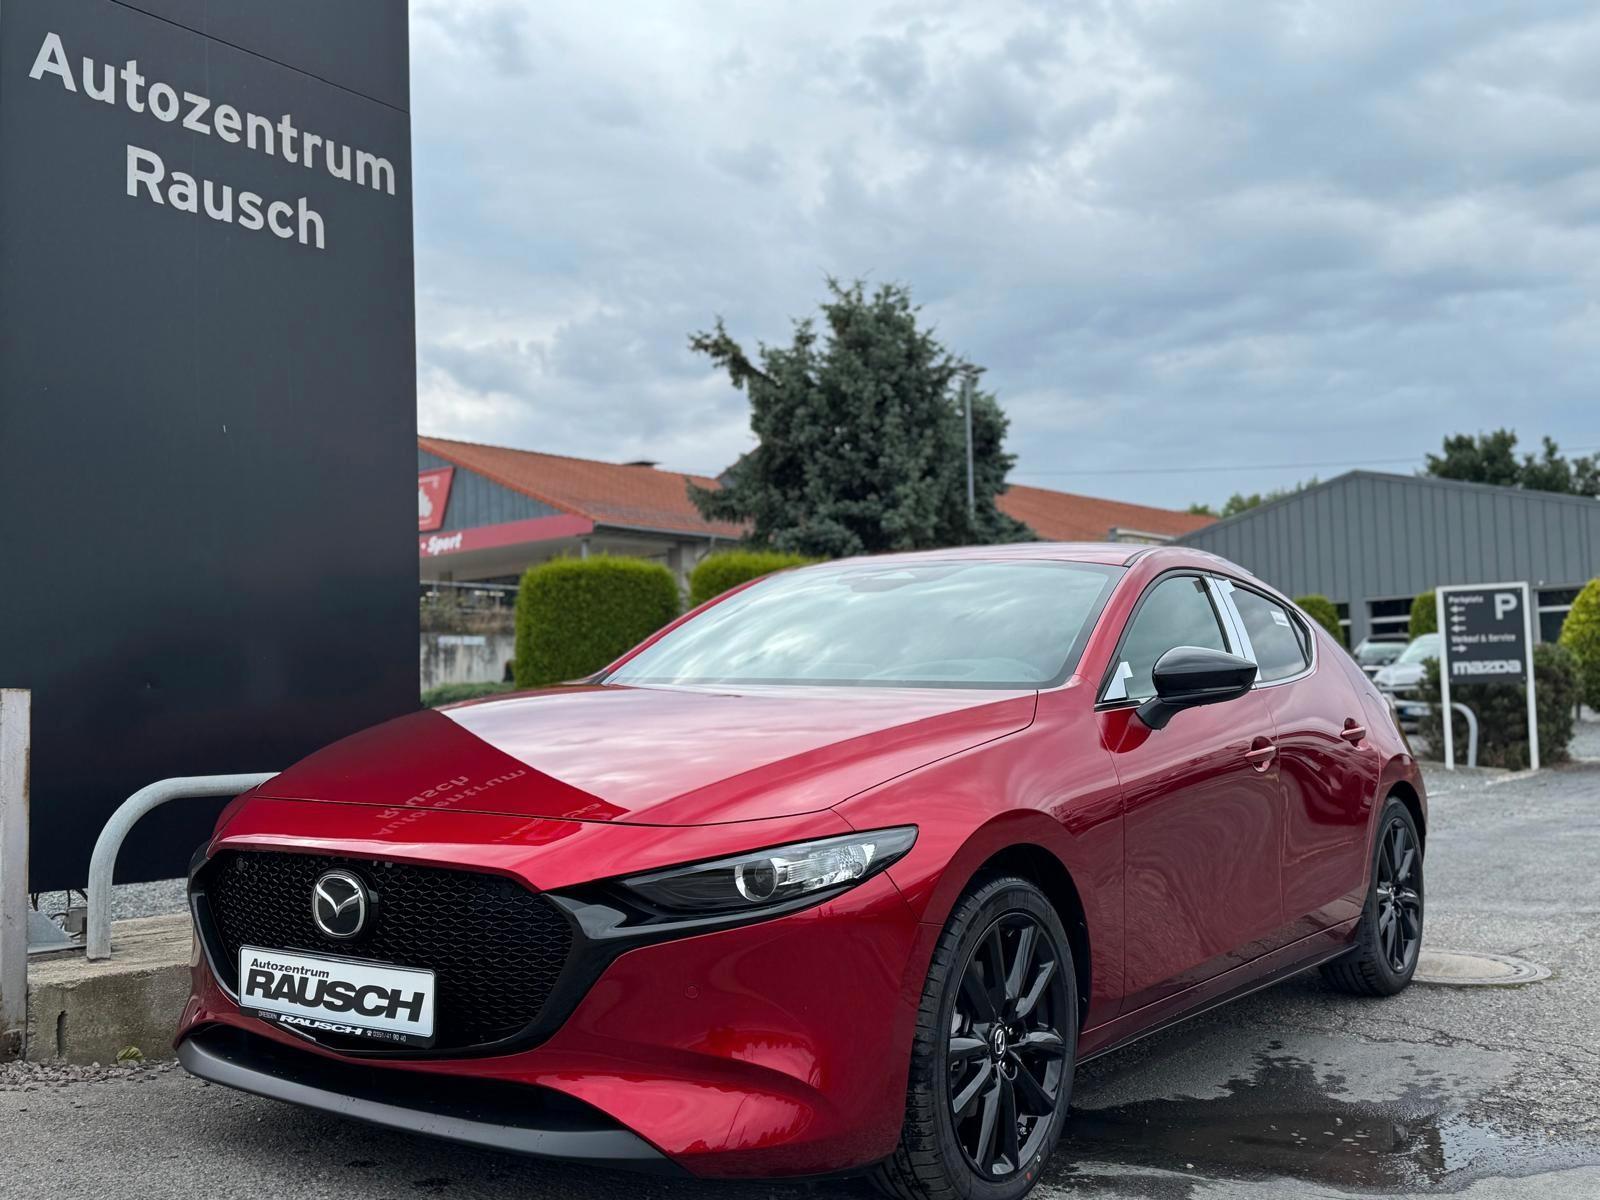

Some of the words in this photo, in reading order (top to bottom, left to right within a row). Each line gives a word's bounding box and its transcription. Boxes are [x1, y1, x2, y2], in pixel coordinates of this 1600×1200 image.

[29, 32, 395, 195] Autozentrum
[126, 144, 326, 249] Rausch
[1494, 593, 1518, 620] P
[1488, 633, 1516, 642] Service
[1452, 659, 1522, 675] mazda
[250, 958, 330, 979] Autozentrum
[245, 968, 425, 1023] RAUSCH
[279, 1015, 363, 1036] RAUSCH
